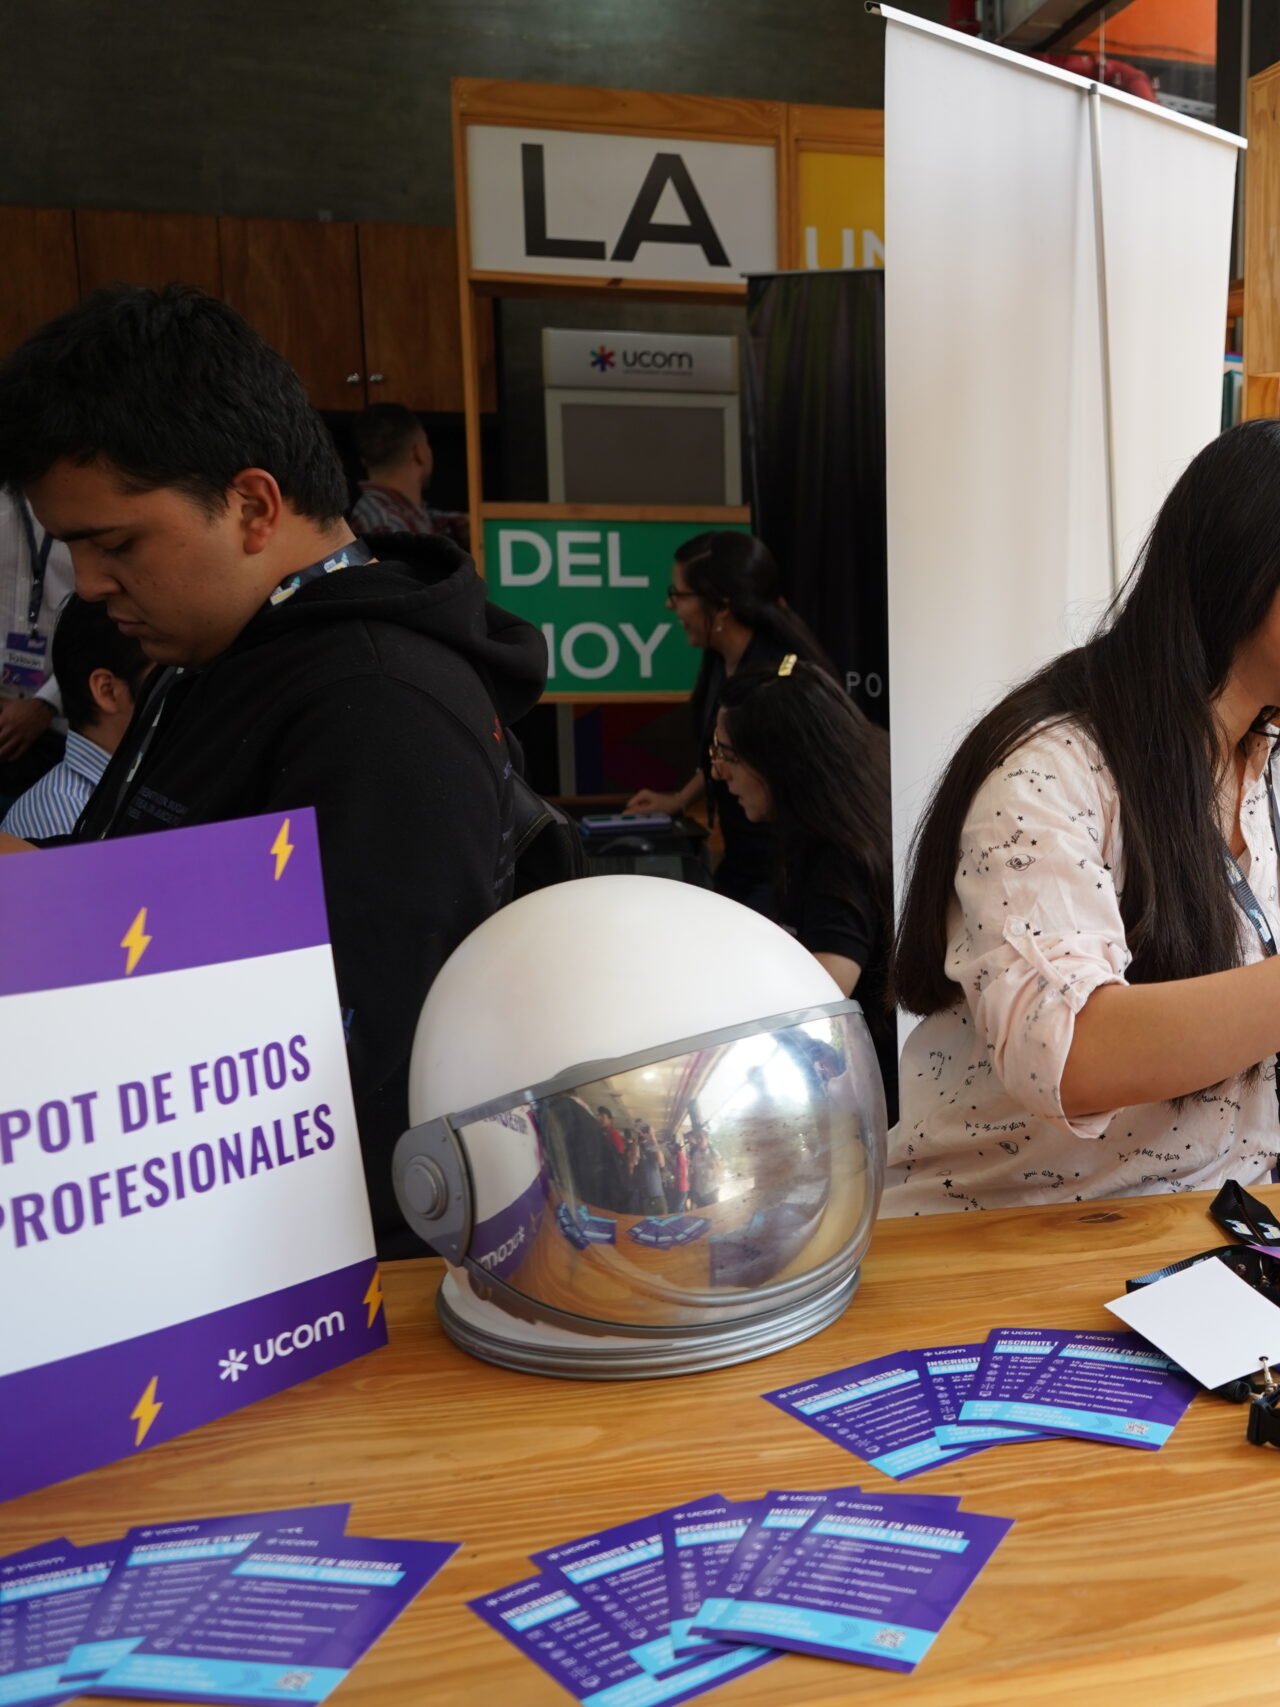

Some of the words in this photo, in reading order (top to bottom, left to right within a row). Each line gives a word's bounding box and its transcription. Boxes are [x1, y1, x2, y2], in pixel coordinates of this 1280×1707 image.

[521, 143, 732, 267] LA
[623, 351, 693, 369] ucom
[498, 529, 649, 588] DEL
[846, 671, 882, 698] PO
[118, 1072, 176, 1134] DE
[190, 1034, 310, 1114] FOTOS
[0, 1103, 336, 1249] ROFESIONALES
[254, 1310, 345, 1365] ucom
[1065, 1344, 1118, 1354] INSCRIBITE
[823, 1514, 885, 1528] INSCRIBITE
[887, 1522, 903, 1530] EN
[905, 1524, 965, 1539] NUESTRAS
